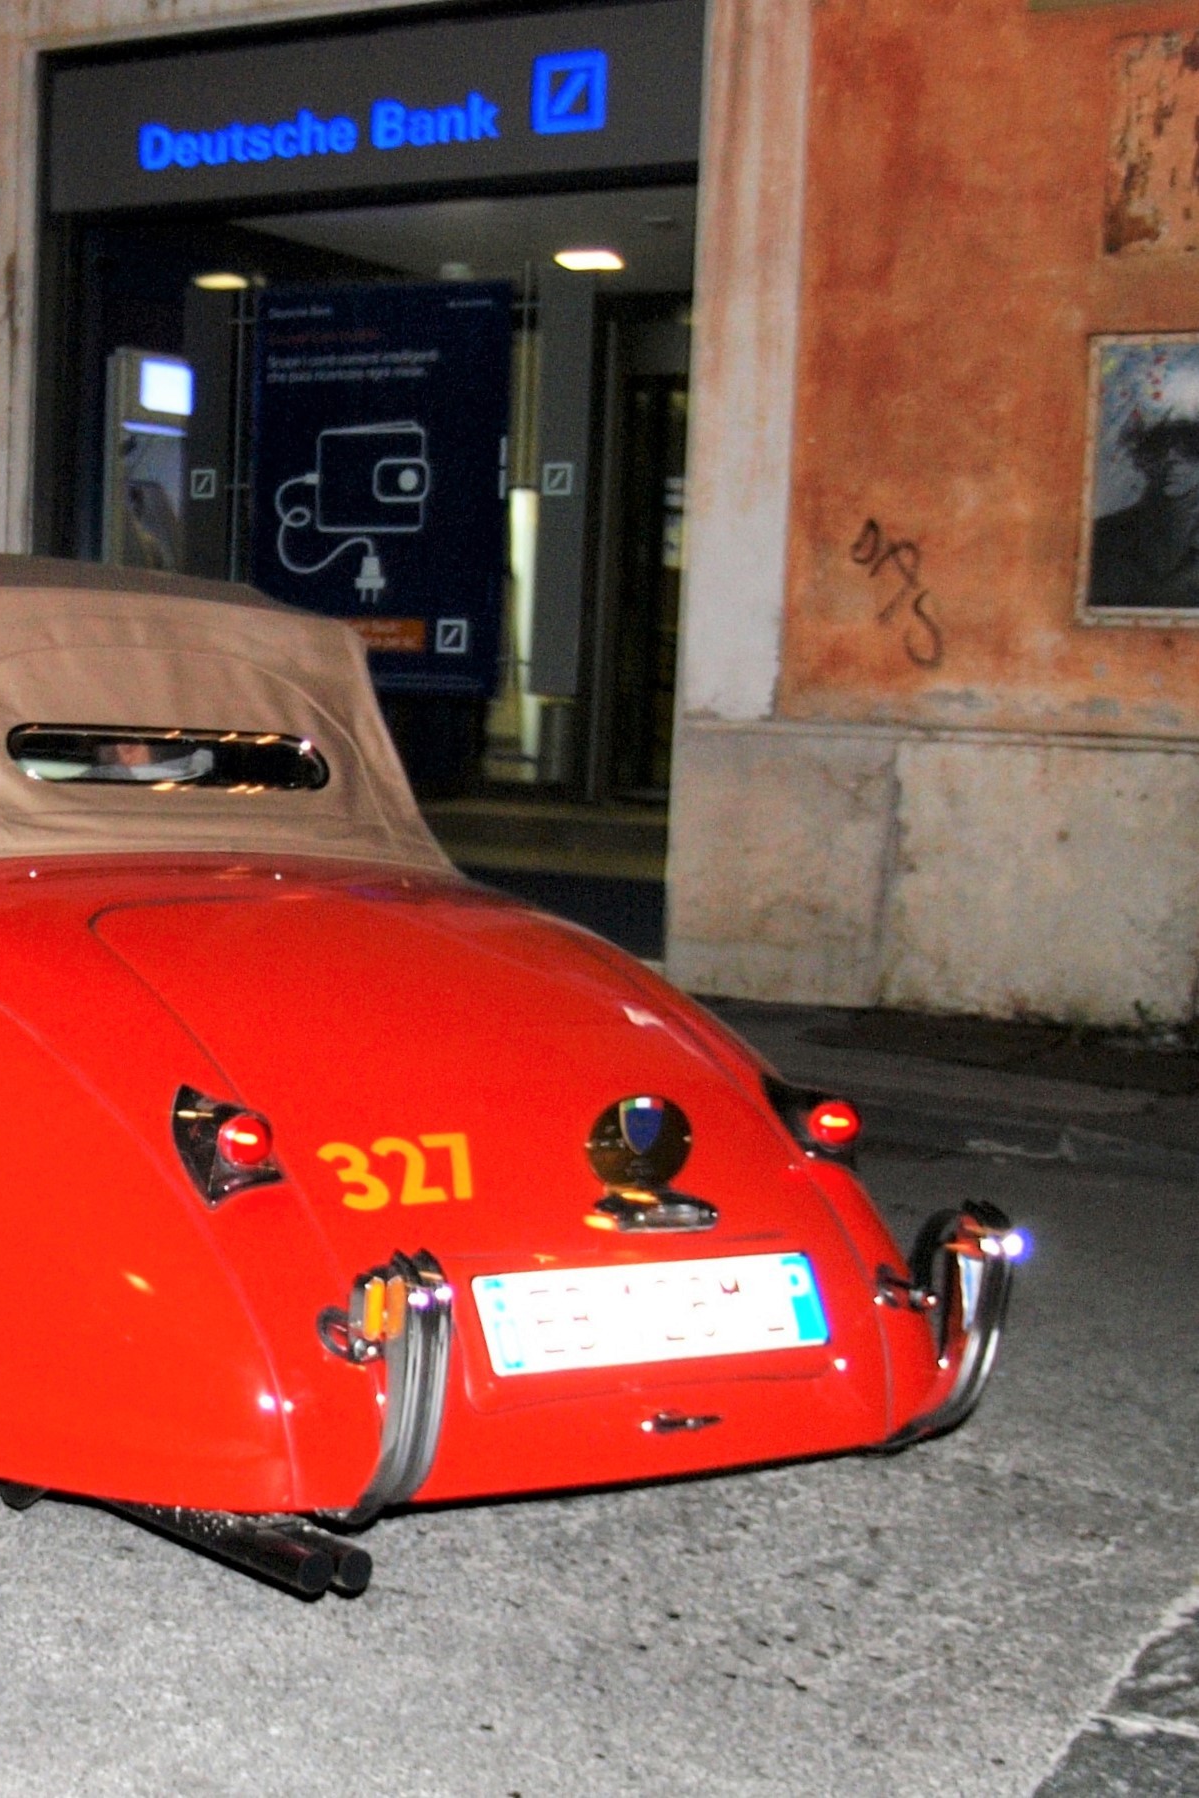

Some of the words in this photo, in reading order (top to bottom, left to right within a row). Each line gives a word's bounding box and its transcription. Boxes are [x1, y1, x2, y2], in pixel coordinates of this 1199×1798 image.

[137, 107, 360, 172] Deutsche
[369, 90, 501, 151] Bank
[317, 1133, 474, 1212] 327
